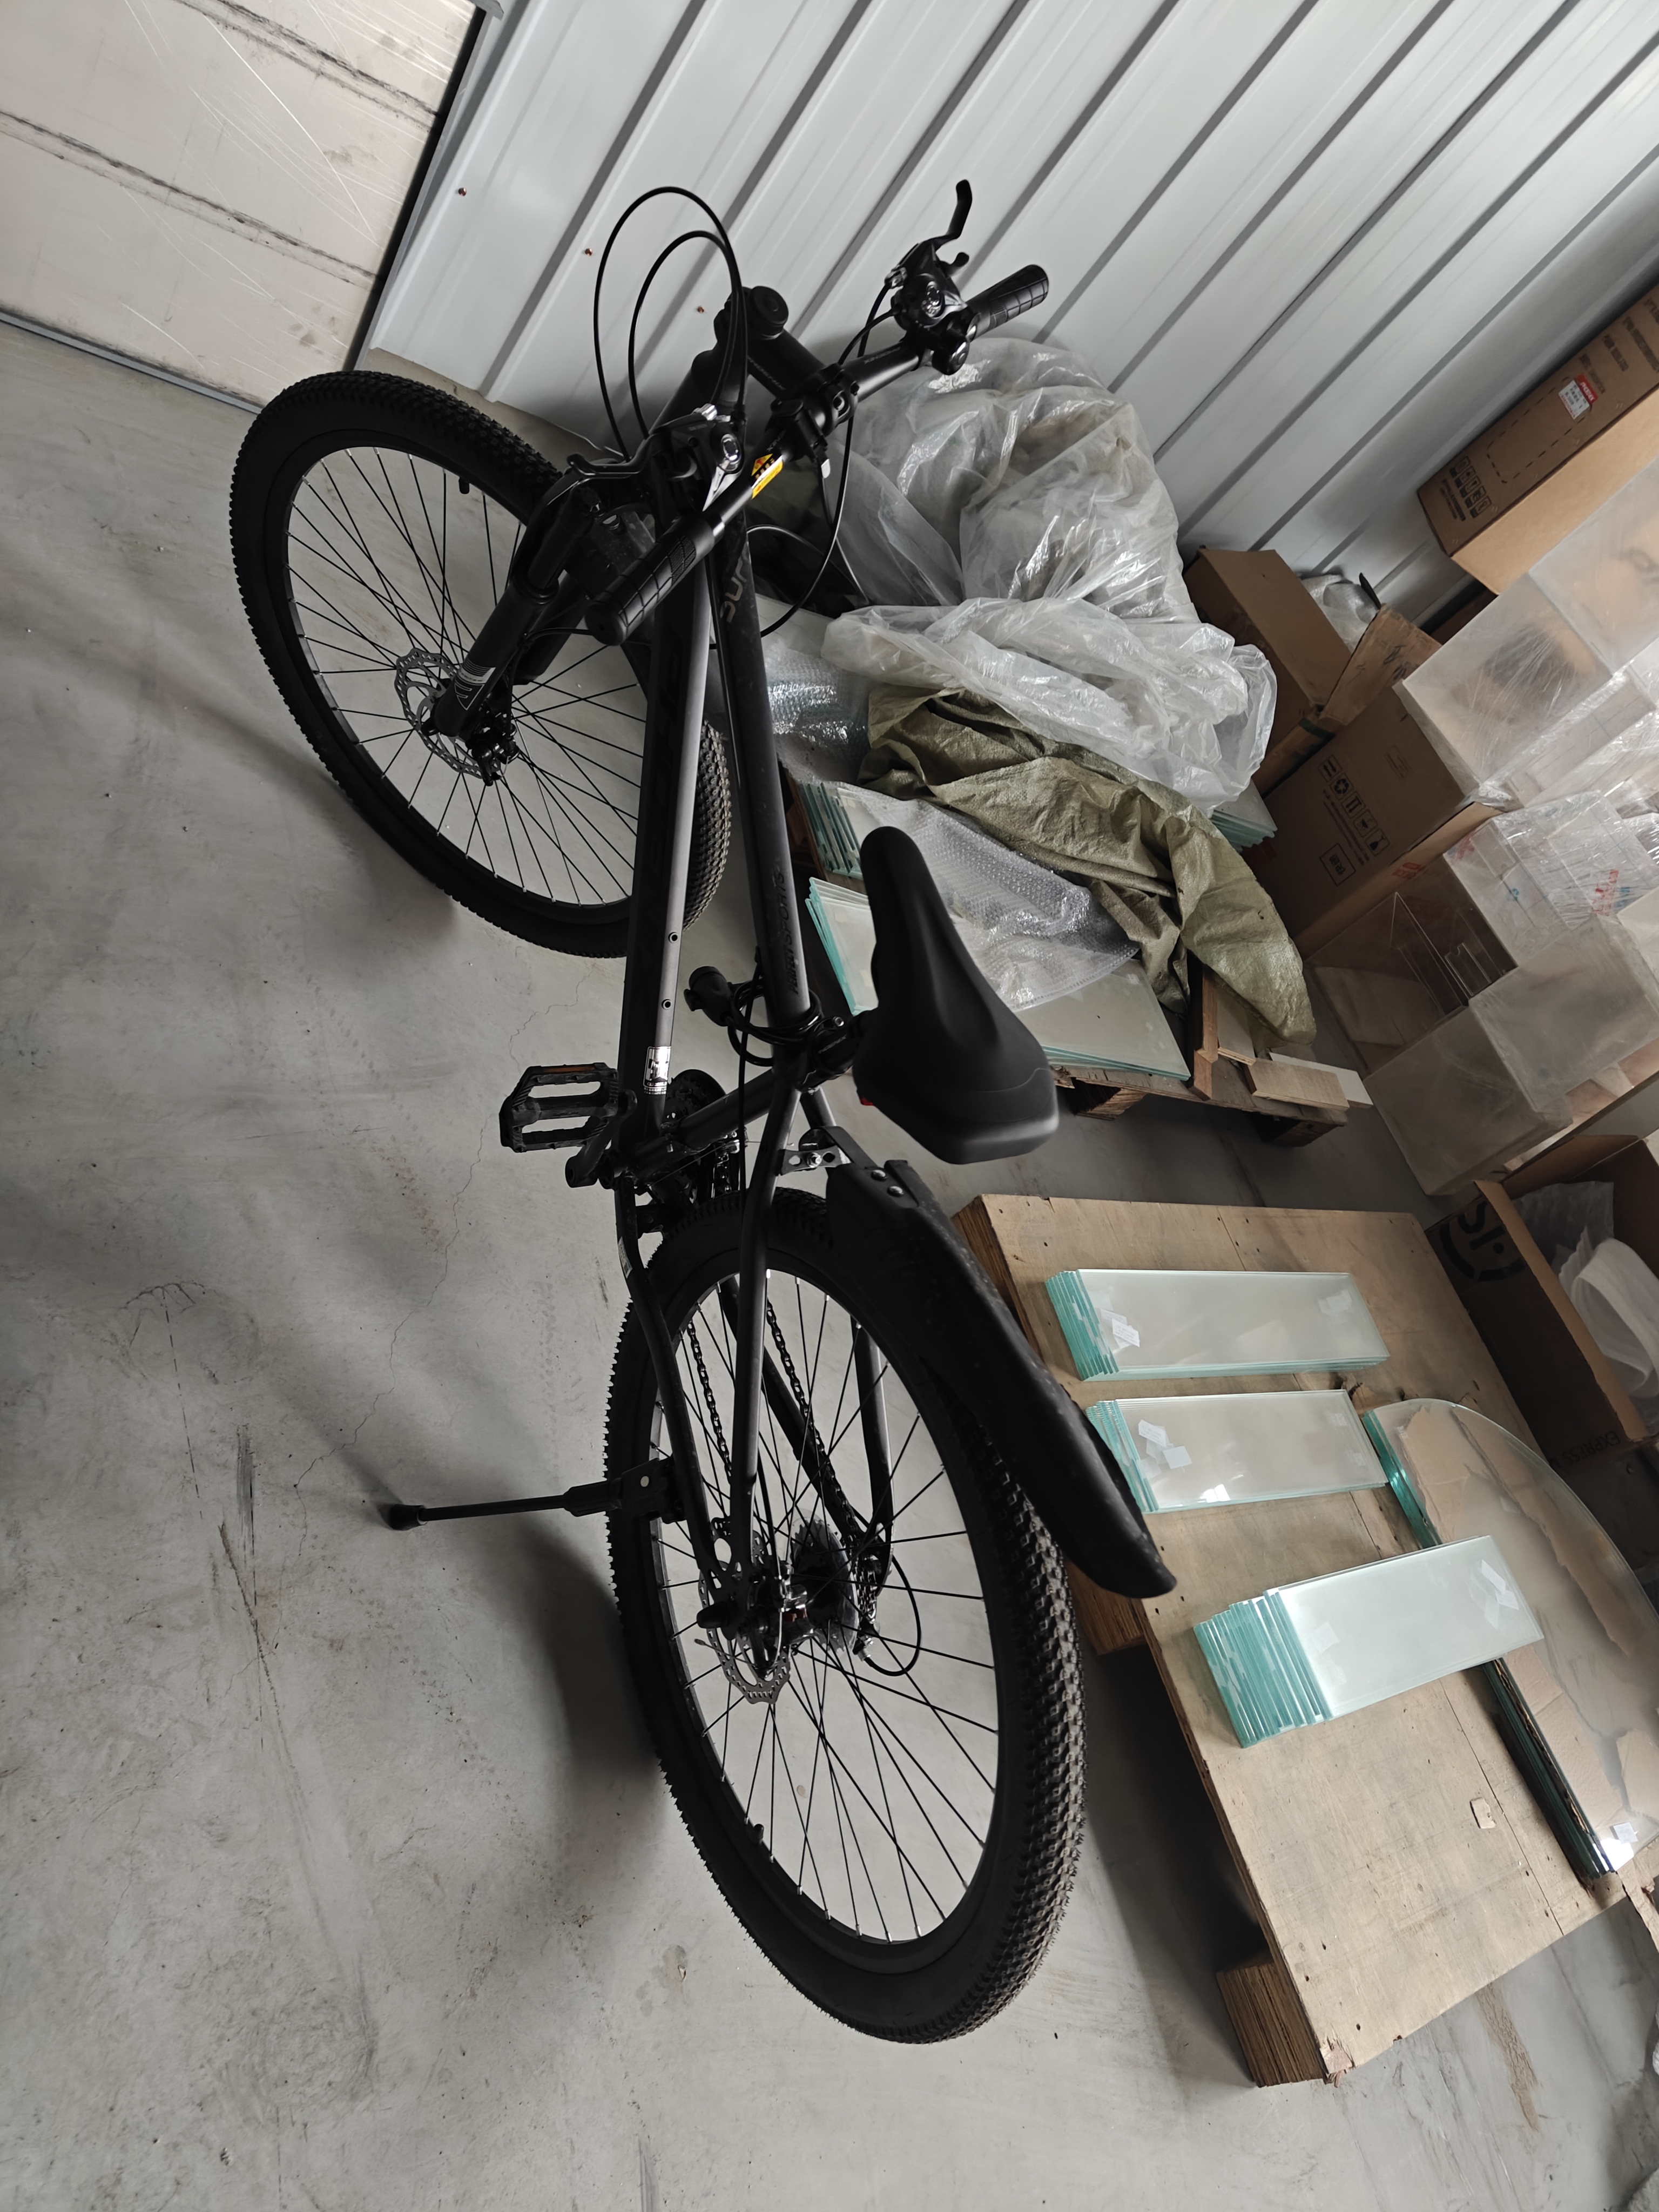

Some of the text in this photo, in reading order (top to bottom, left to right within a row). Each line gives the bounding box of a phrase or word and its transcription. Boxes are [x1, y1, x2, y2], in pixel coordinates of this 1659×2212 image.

[1327, 852, 1346, 876] 快递
[773, 867, 798, 994] PERFECT SPORTS
[1561, 1430, 1621, 1466] EXPRESS
